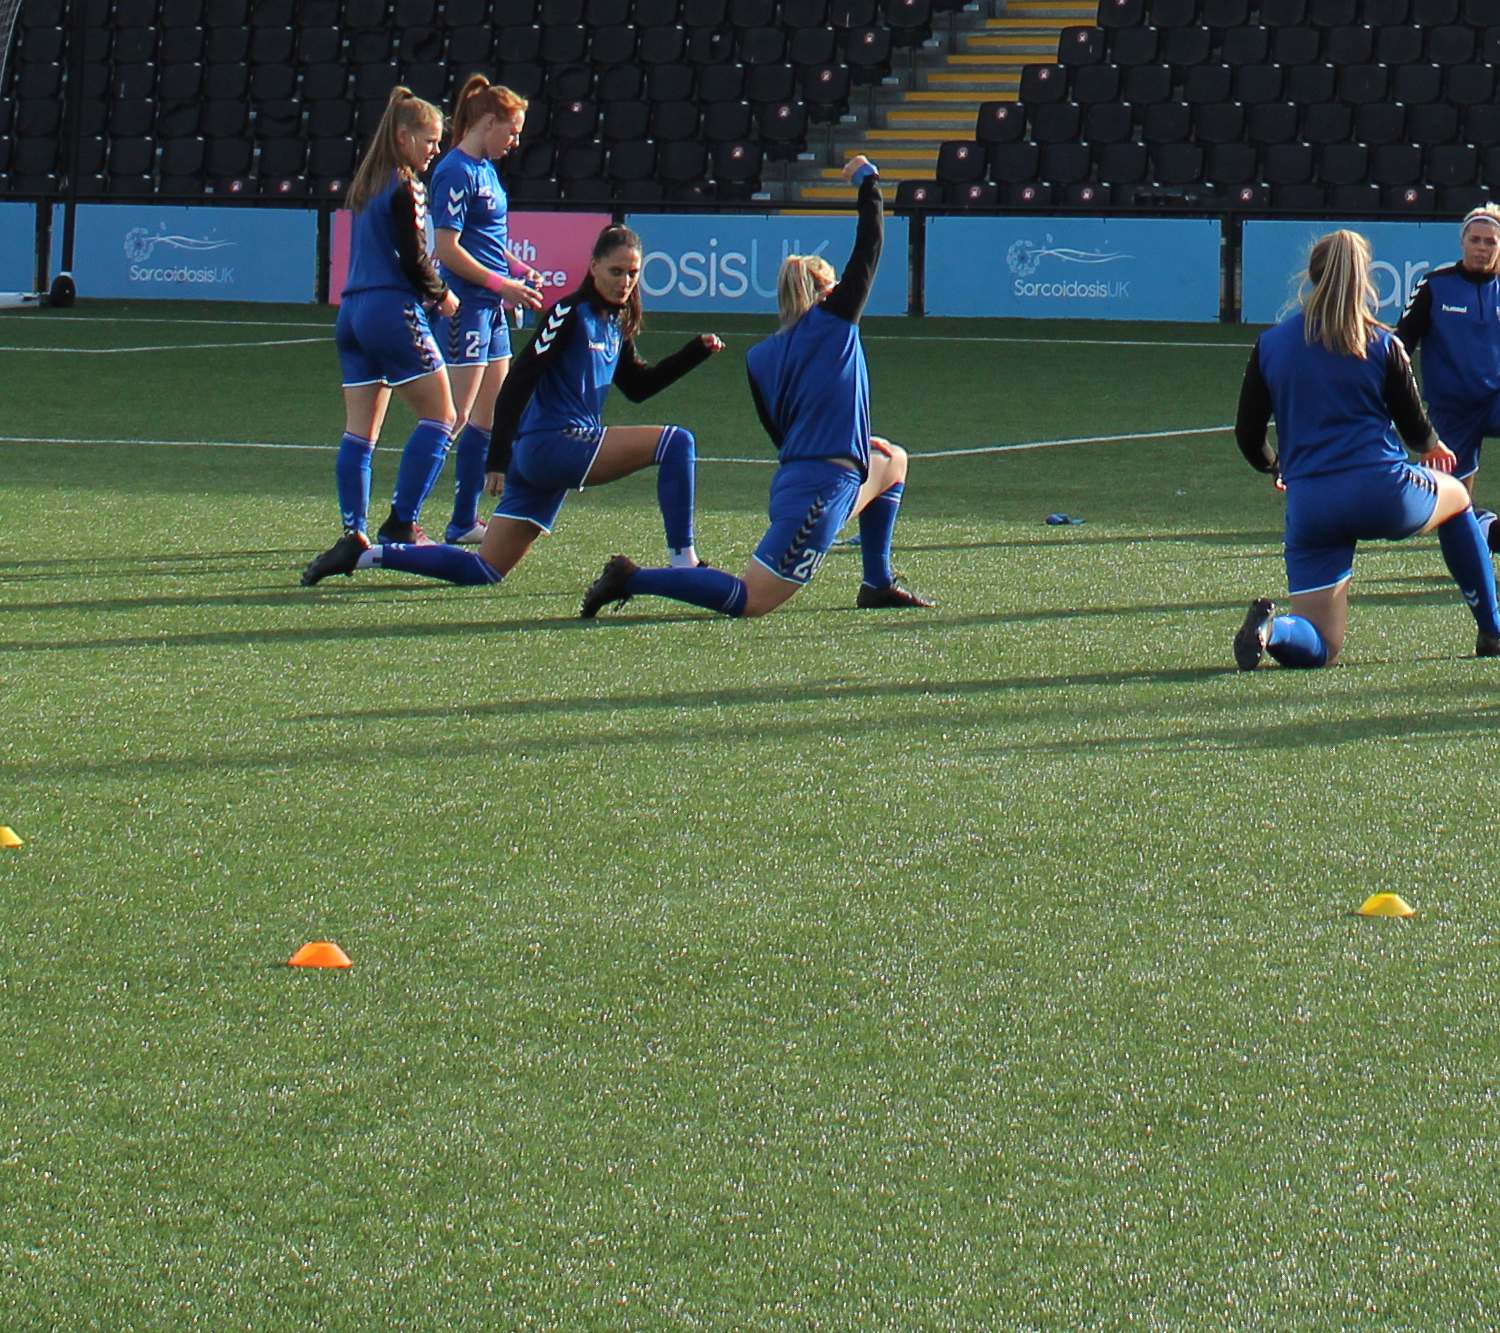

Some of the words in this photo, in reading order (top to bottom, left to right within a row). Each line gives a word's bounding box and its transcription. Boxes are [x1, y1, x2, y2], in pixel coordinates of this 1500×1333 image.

[130, 265, 234, 282] SarcoidosisUK
[1014, 279, 1130, 298] SarcoidosisUK
[466, 331, 480, 358] 2
